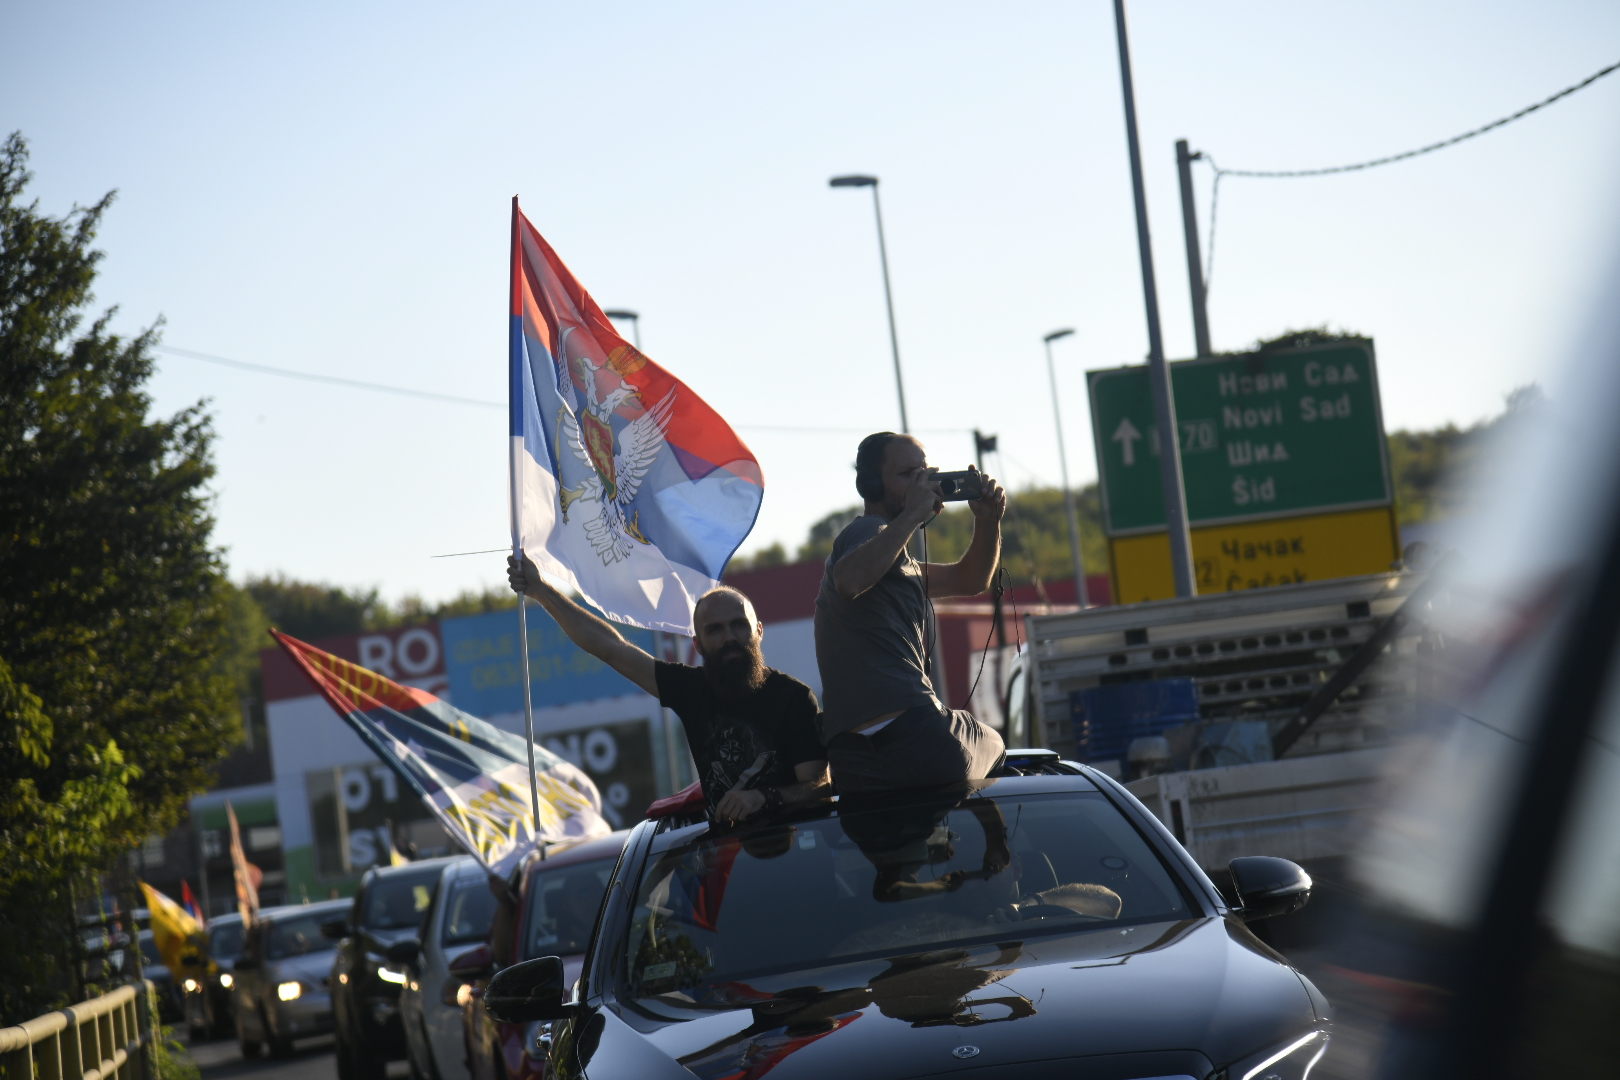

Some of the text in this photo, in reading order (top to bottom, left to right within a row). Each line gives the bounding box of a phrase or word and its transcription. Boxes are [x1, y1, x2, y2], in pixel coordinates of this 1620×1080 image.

[1304, 361, 1359, 388] Сад
[1222, 392, 1352, 430] Novi Sad
[1227, 440, 1290, 467] Шид
[1232, 474, 1276, 506] Šid
[1221, 536, 1305, 561] Чачак
[1195, 560, 1213, 584] 2
